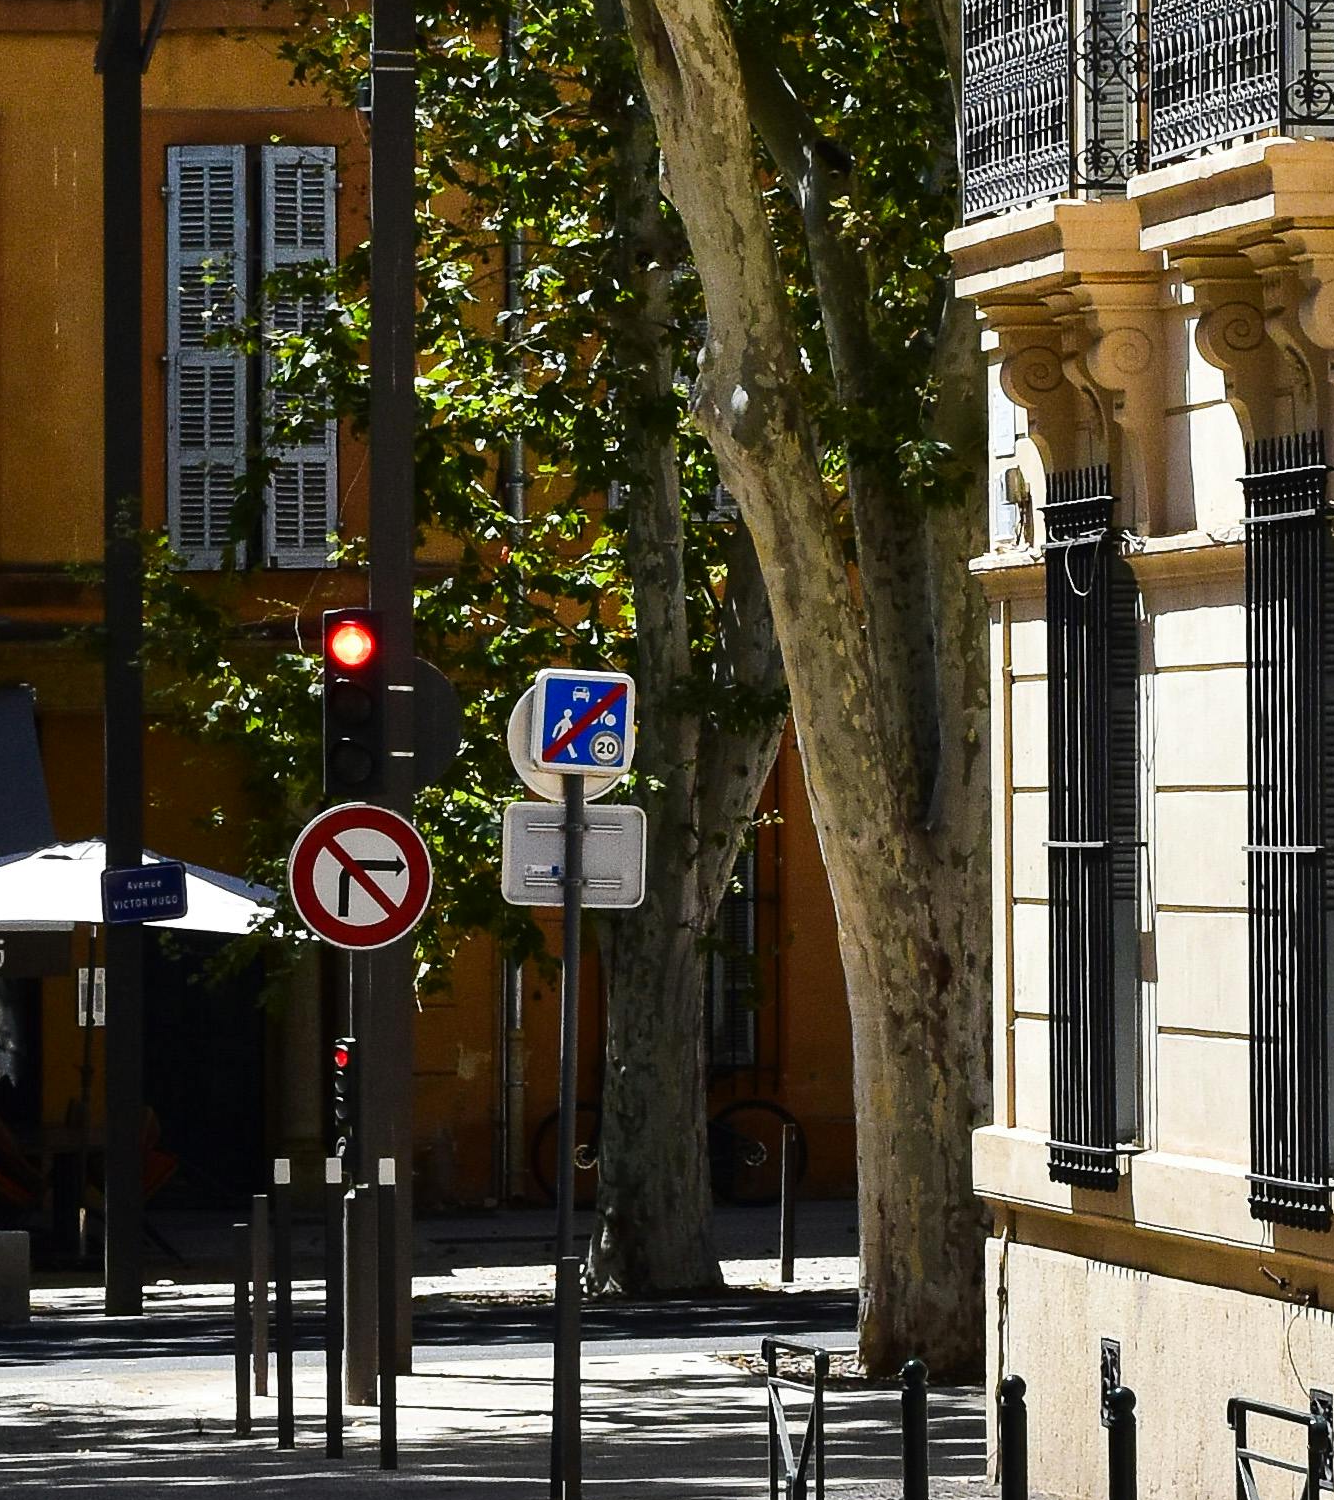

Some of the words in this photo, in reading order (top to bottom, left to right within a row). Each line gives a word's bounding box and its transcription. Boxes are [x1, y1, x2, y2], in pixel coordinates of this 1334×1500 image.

[597, 741, 615, 754] 20
[113, 898, 148, 910] VICTOR
[151, 895, 178, 906] HUGO
